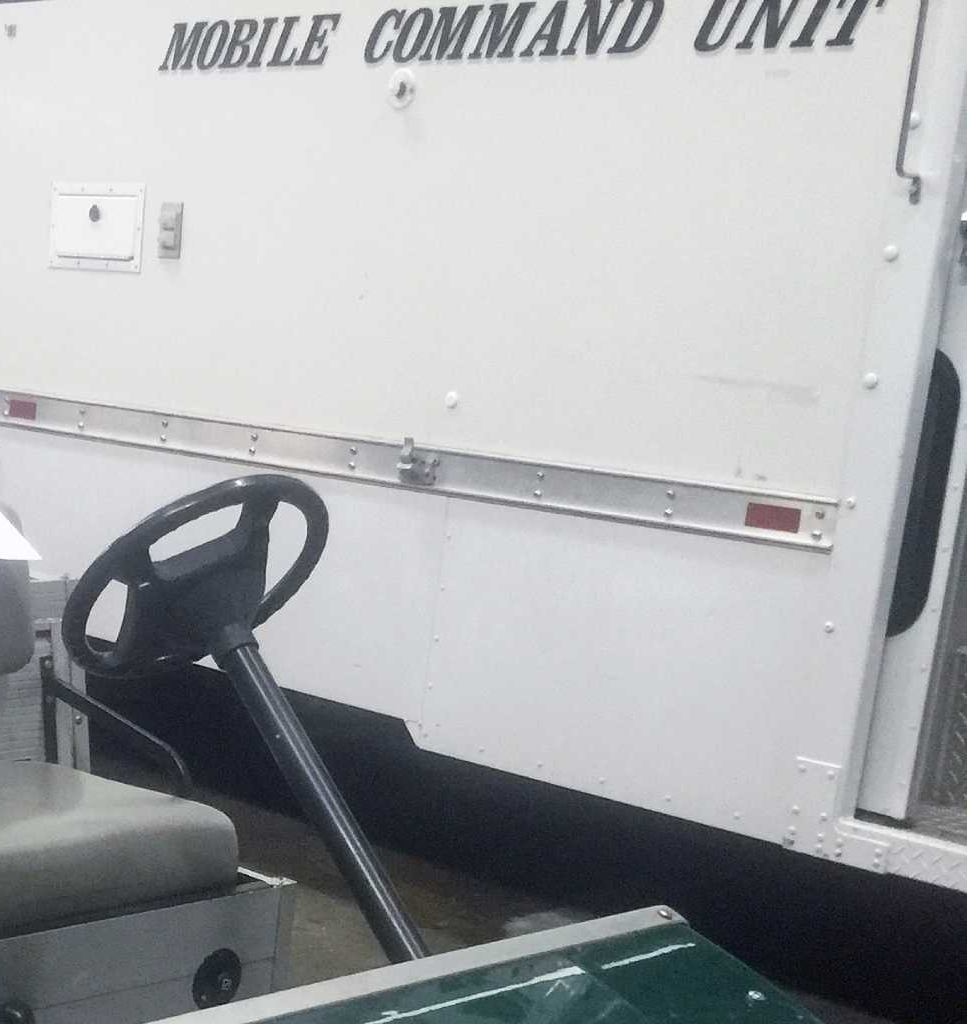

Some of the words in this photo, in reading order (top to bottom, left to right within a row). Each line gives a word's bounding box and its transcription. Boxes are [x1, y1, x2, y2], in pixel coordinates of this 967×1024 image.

[158, 13, 339, 71] MOBILE
[363, 0, 661, 63] COMMAND
[694, 0, 885, 51] UNIT
